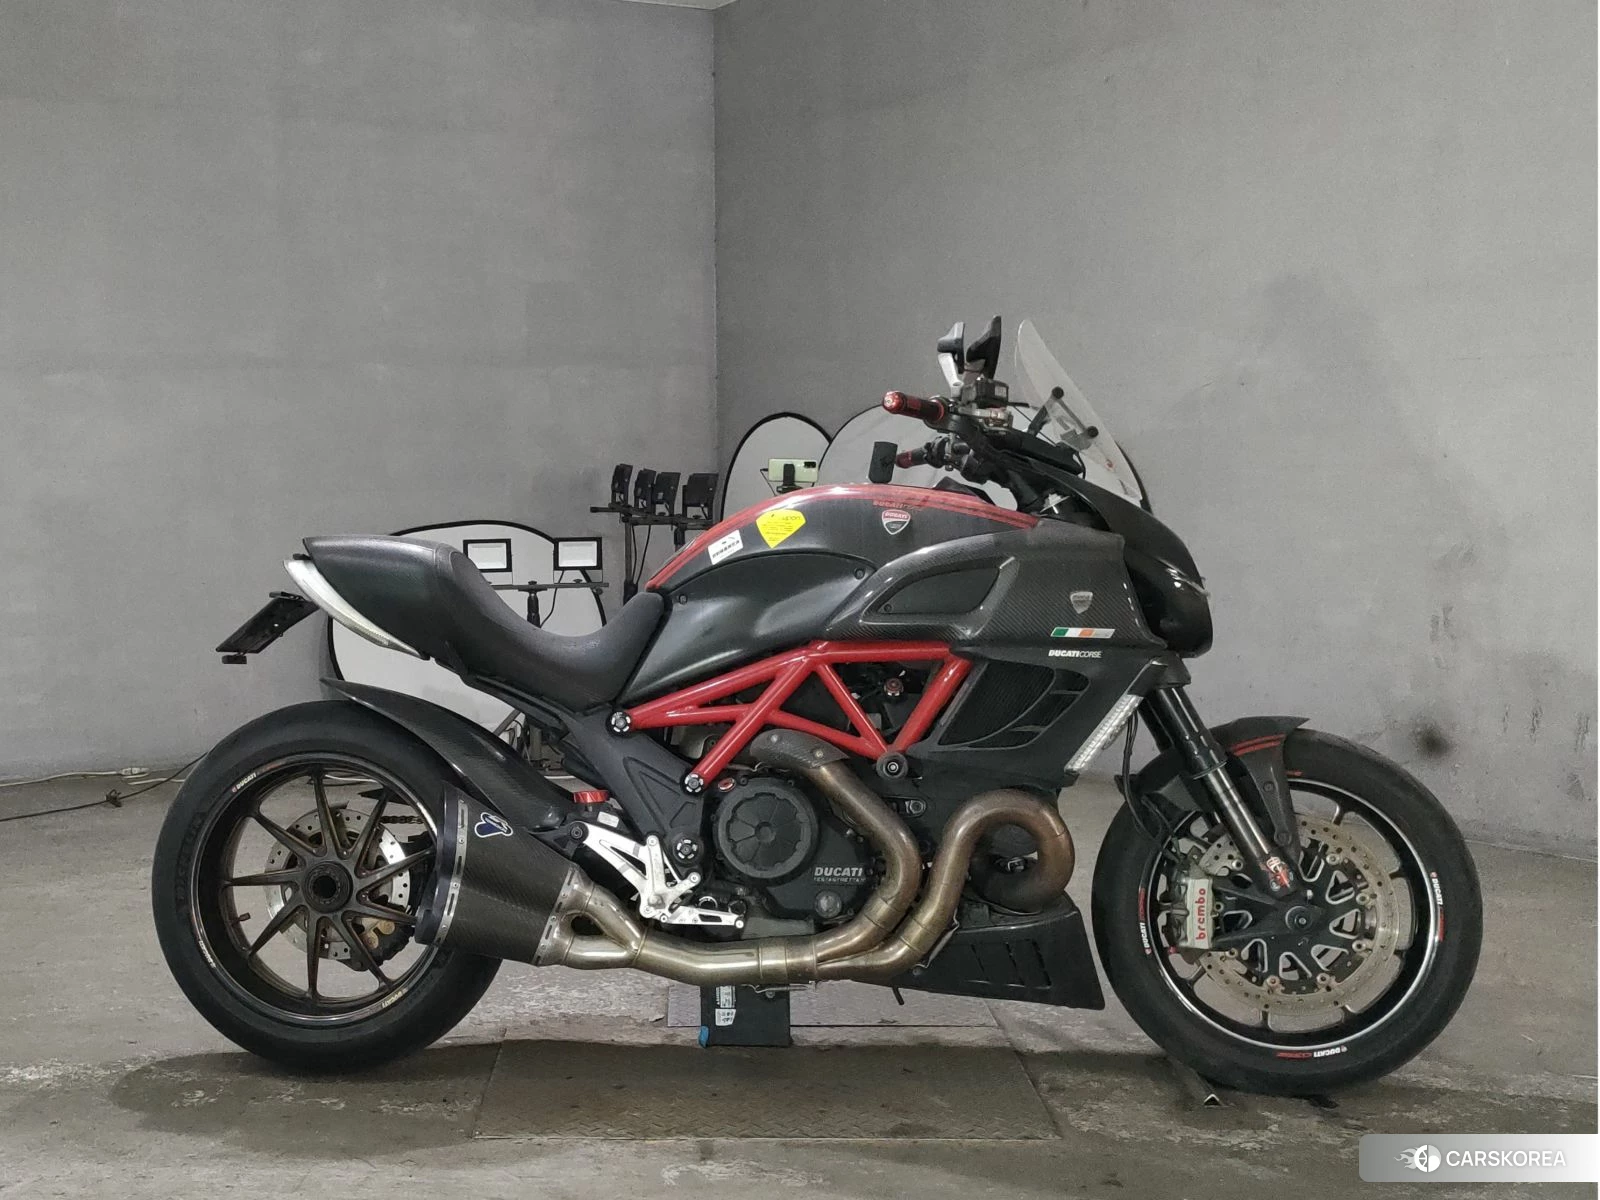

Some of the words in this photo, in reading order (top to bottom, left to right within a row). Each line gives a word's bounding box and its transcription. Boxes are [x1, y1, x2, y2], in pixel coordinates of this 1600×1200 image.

[814, 867, 863, 876] DUCATI
[1432, 878, 1443, 905] DUCATI
[1195, 888, 1206, 940] brembo
[1140, 922, 1150, 948] DUCATI
[1314, 1047, 1340, 1058] DUCATI
